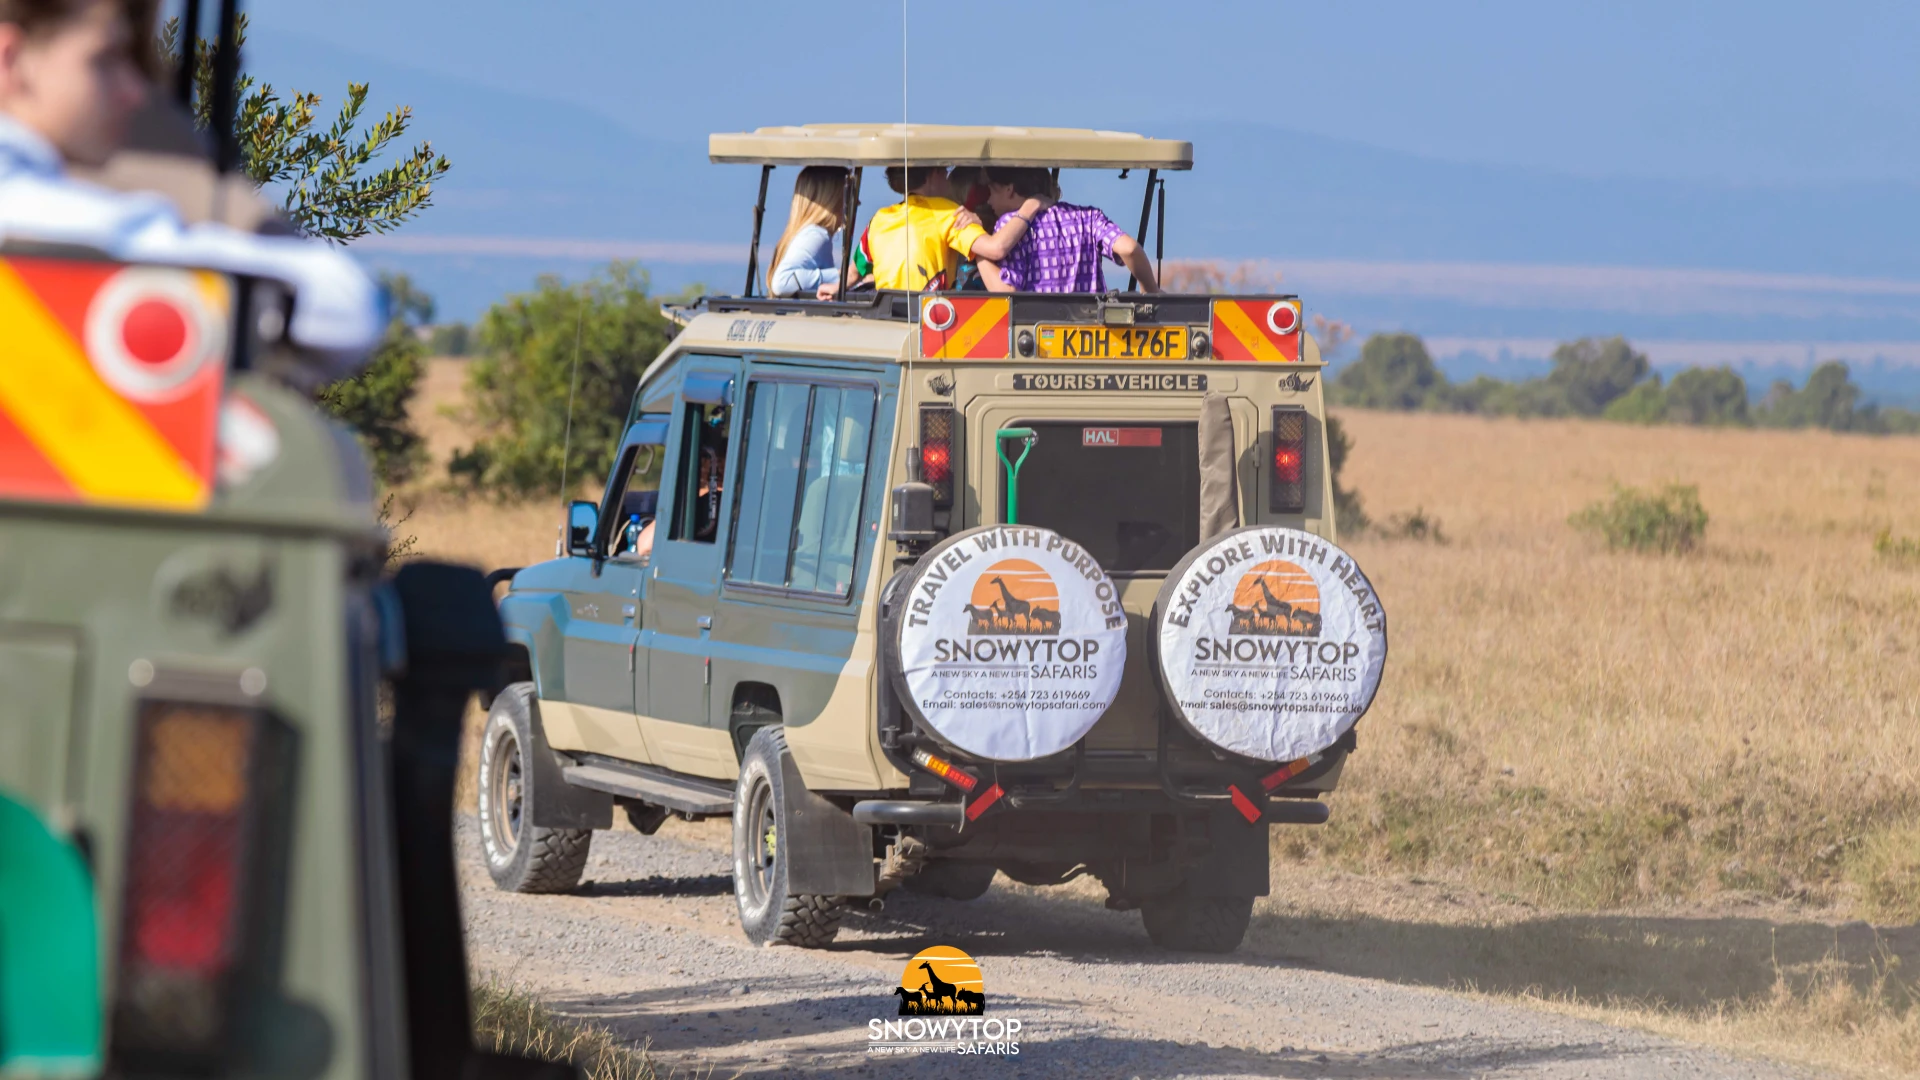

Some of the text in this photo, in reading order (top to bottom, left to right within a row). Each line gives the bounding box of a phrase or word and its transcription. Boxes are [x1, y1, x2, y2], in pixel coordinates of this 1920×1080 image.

[1063, 329, 1180, 357] KDH 176F
[1022, 374, 1199, 390] TOURIST VEHICLE
[1086, 431, 1115, 443] HAL
[908, 528, 1122, 631] TRAVEL WITH PURPOSE
[1168, 534, 1383, 633] EXPLORE WITH HEART
[934, 639, 1099, 663] SNOWYTOP
[1195, 638, 1360, 665] SNOWYTOP
[1031, 664, 1097, 679] SAFARIS
[1199, 669, 1220, 677] NEW
[1290, 665, 1357, 681] SAFARIS
[944, 690, 1091, 700] Contacts: +254 723 619669
[1204, 689, 1349, 701] Contacts: +254 723 619669
[923, 700, 1106, 711] Email: sales@snowytopsafari.com
[1209, 701, 1363, 714] sales@snowytopsafari.co.ke
